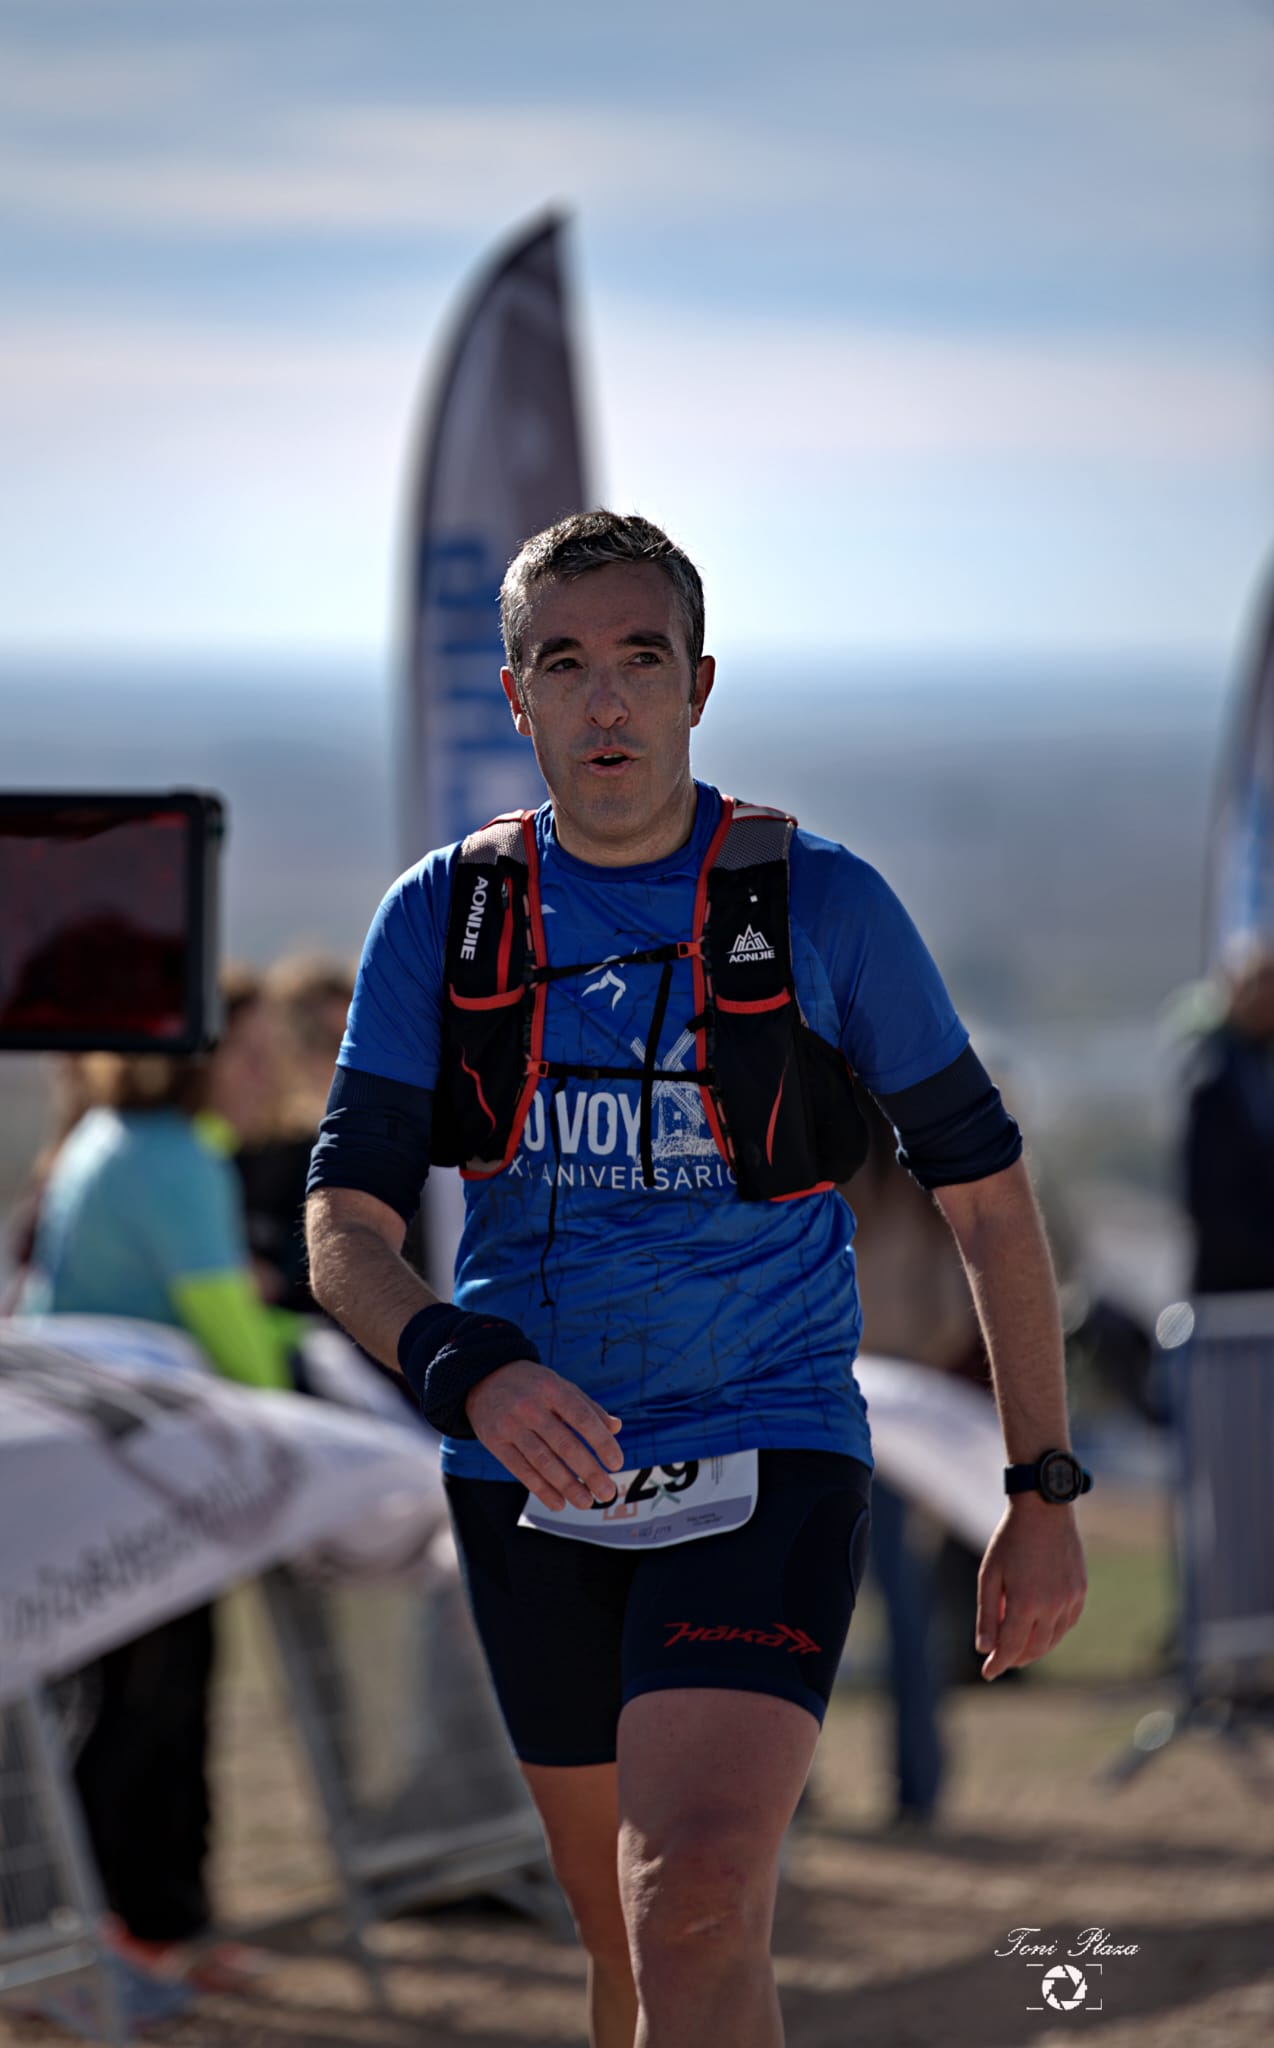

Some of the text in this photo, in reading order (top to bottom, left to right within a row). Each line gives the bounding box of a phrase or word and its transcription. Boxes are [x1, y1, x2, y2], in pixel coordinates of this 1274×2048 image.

[460, 876, 489, 960] AONIJIE
[728, 949, 776, 963] AONIJIE
[555, 1091, 642, 1157] VOY
[591, 1459, 700, 1510] 29
